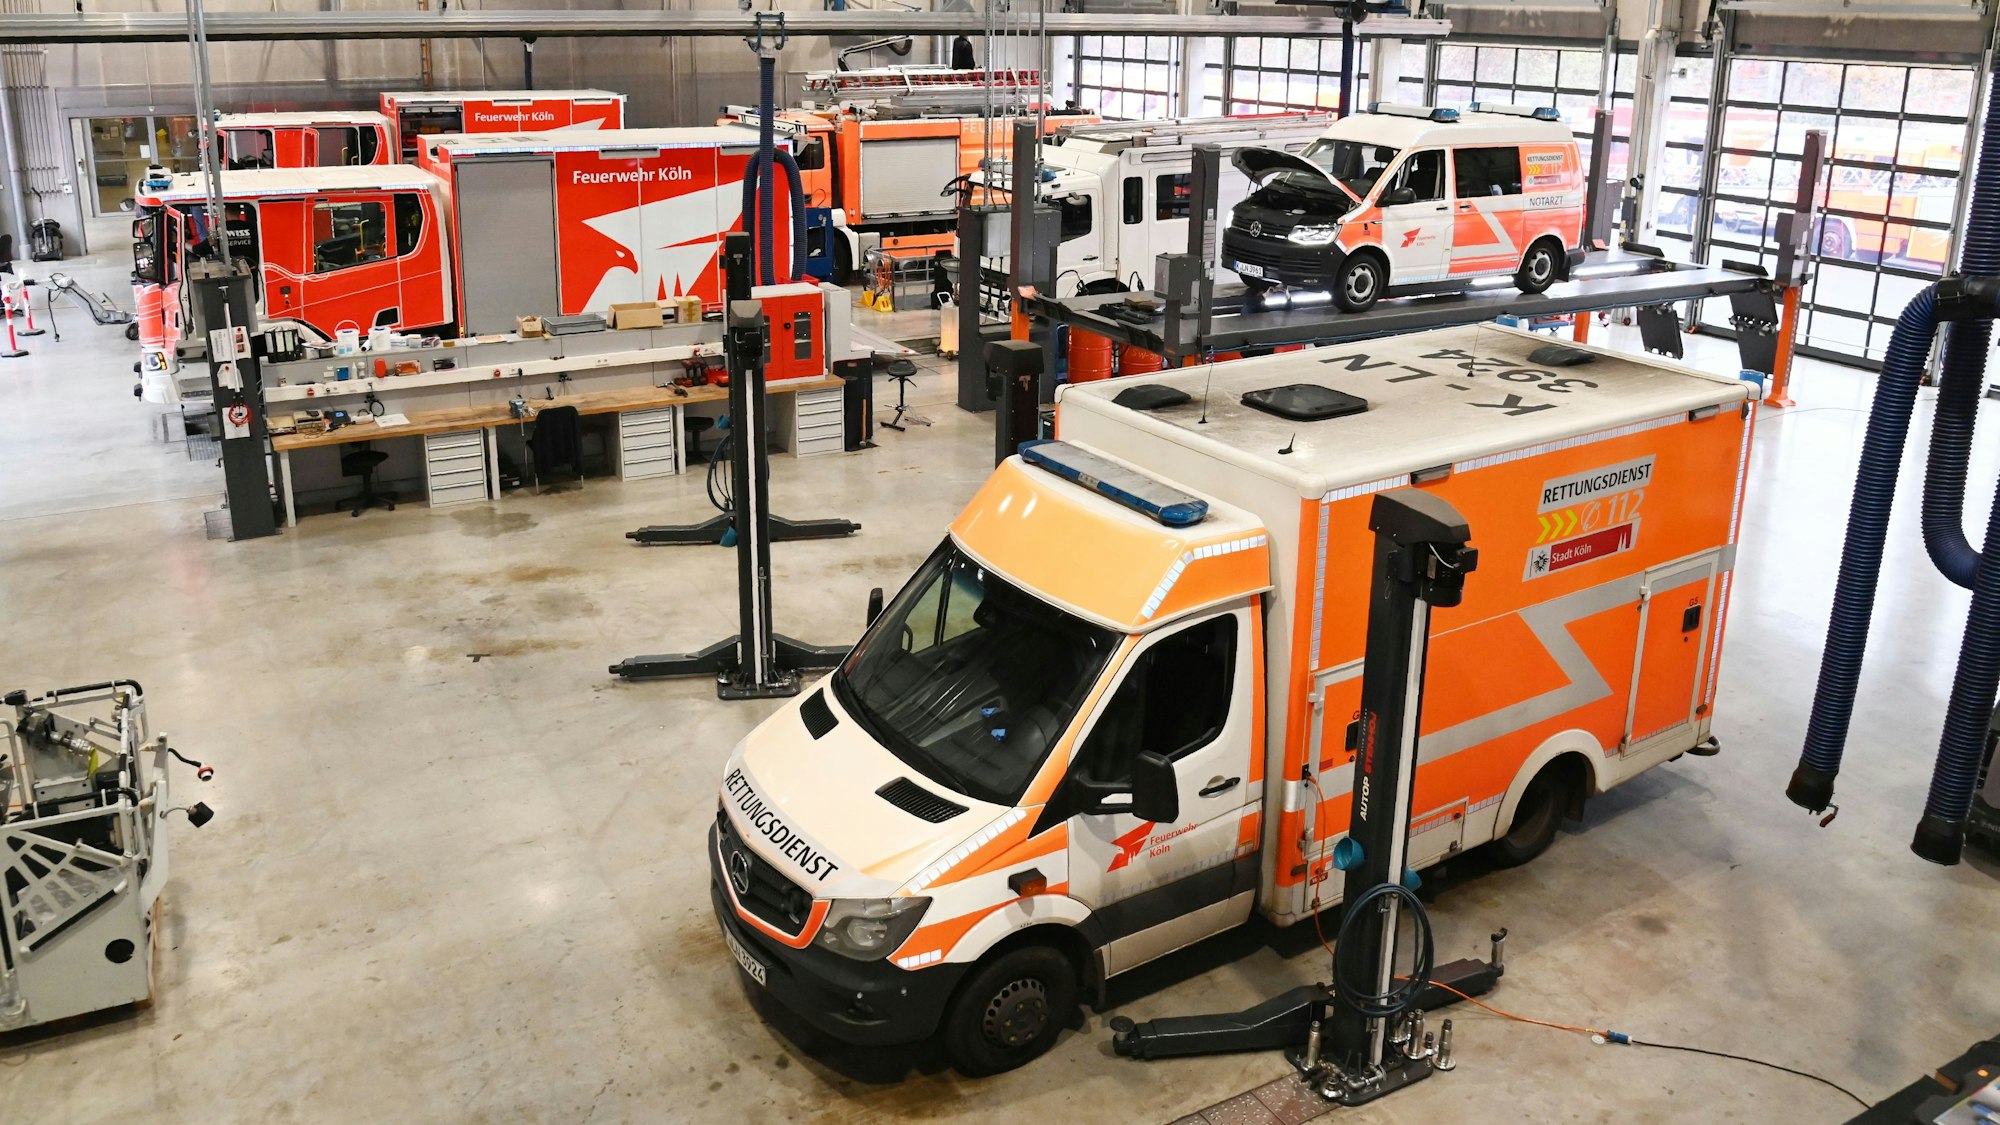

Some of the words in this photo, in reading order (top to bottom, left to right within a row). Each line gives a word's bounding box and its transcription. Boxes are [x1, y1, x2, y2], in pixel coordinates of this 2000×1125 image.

[474, 112, 531, 122] Feuerwehr
[532, 111, 555, 121] Köln
[572, 168, 656, 185] Feuerwehr
[658, 165, 692, 182] Köln
[1529, 195, 1564, 206] NOTARZT
[1418, 348, 1599, 393] 3924
[1543, 463, 1652, 504] RETTUNGSDIENST
[1607, 489, 1645, 526] 112
[1552, 548, 1573, 564] Stadt
[1574, 543, 1592, 557] Köln
[1360, 775, 1371, 822] AUTOP
[725, 768, 839, 882] RETTUNGSDIENST
[1150, 822, 1199, 846] Feuerwehr
[1149, 843, 1171, 859] Köln
[741, 950, 764, 982] 3924
